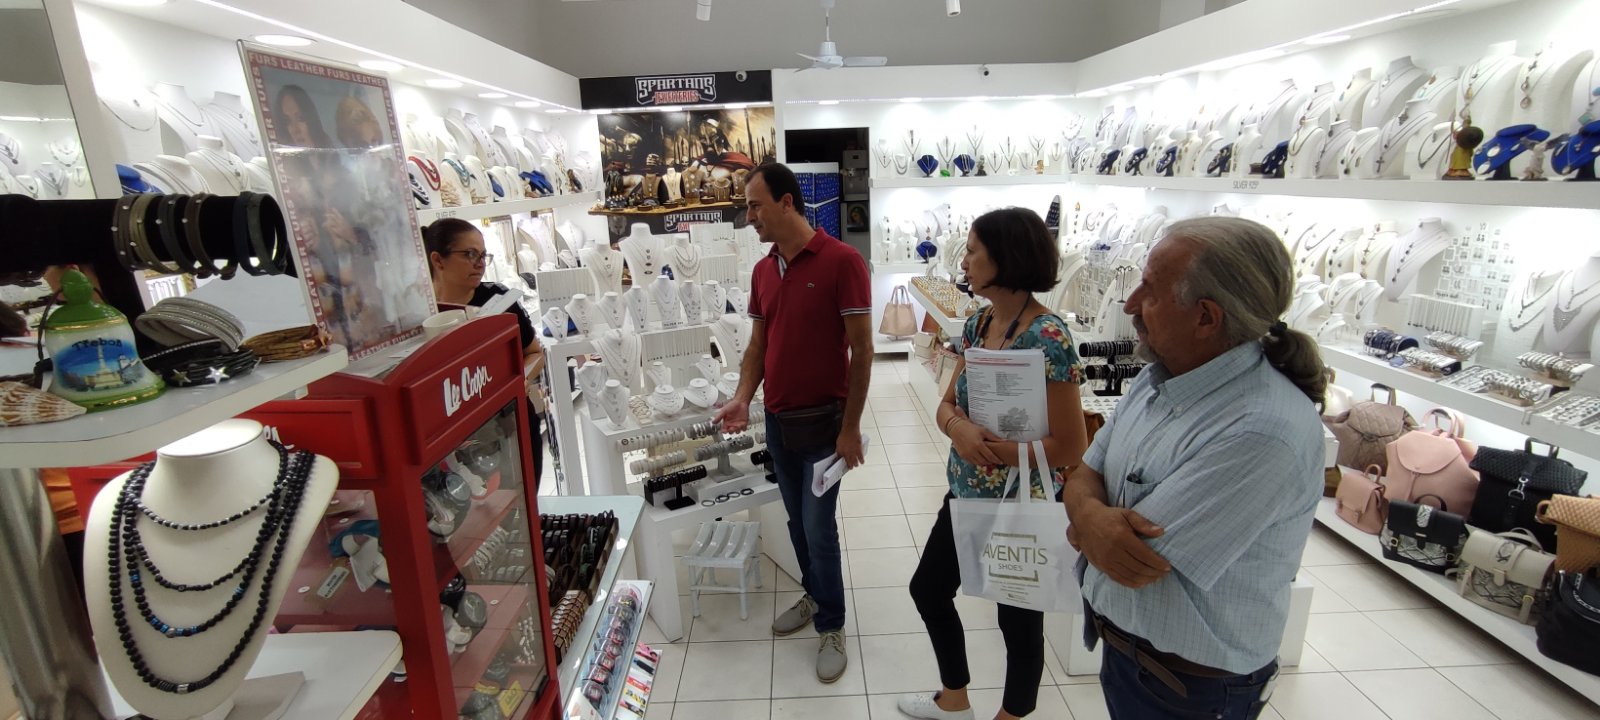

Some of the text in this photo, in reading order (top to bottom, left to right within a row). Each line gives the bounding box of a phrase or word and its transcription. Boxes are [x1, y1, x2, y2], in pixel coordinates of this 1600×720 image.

[249, 52, 278, 67] FURS
[280, 58, 326, 77] LEATHER
[326, 69, 351, 81] FURS
[252, 66, 270, 112] FURS
[637, 76, 714, 99] SPARTANS
[285, 200, 303, 241] FURS
[665, 211, 721, 228] SPARTANS
[300, 247, 323, 317] LEATHER
[355, 340, 392, 361] LEATHER
[443, 364, 493, 418] Lee Cooper
[982, 543, 1049, 565] AVENTIS
[998, 563, 1024, 572] SHOES
